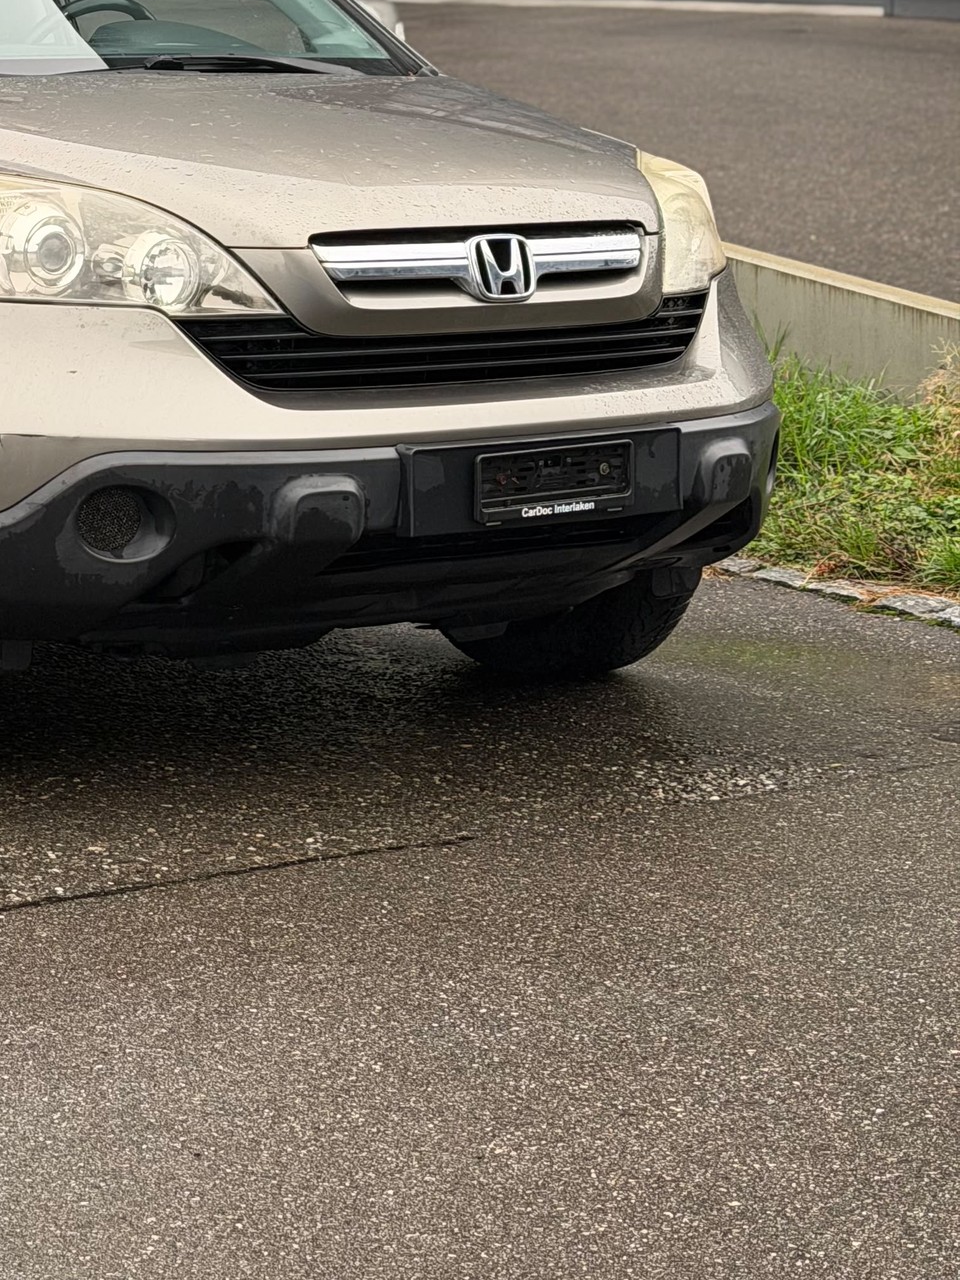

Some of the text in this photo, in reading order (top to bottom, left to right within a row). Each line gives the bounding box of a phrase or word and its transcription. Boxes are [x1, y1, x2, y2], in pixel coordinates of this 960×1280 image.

[478, 237, 527, 297] H
[521, 501, 595, 518] CarDoc Interlaken
